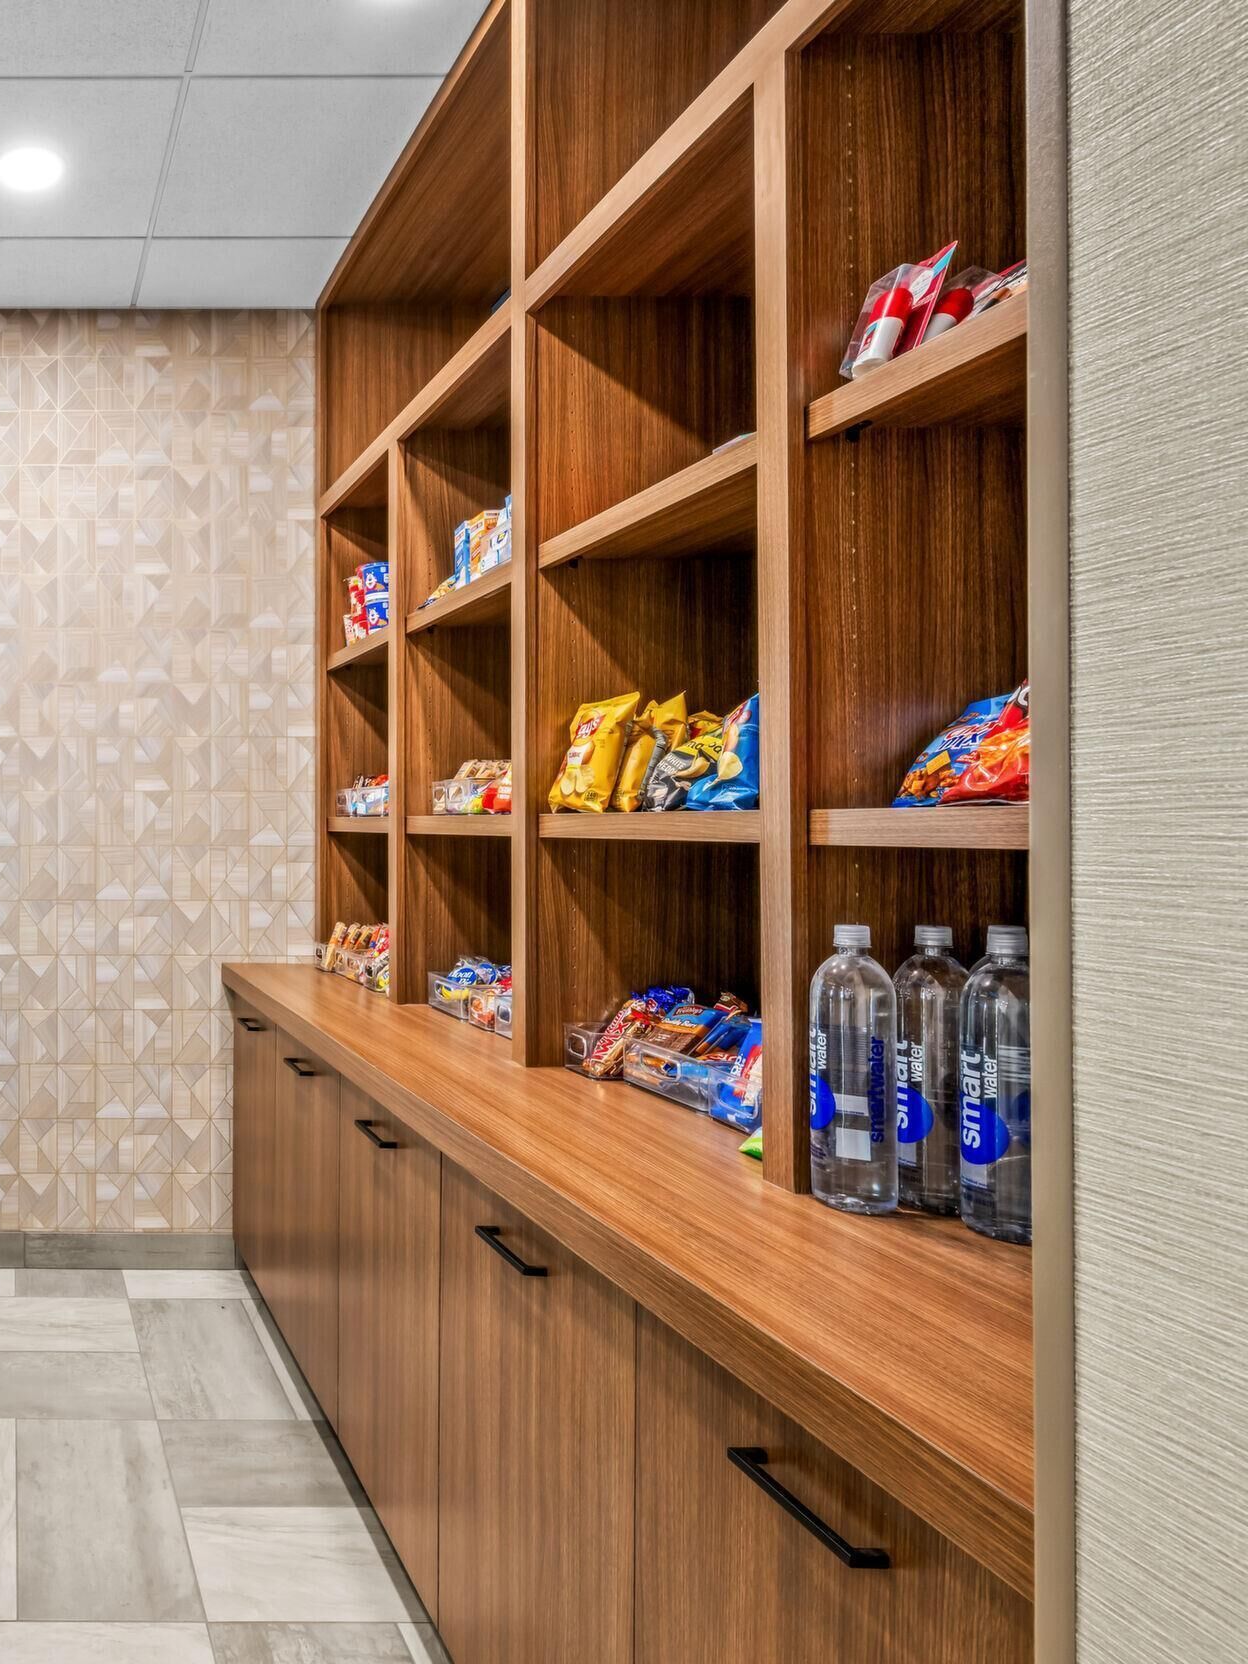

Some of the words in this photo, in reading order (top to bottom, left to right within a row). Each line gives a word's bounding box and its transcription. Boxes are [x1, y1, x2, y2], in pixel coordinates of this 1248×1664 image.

[816, 1029, 827, 1070] water
[909, 1041, 923, 1082] water
[868, 1036, 885, 1143] smartwater
[982, 1055, 997, 1098] water
[961, 1050, 981, 1149] smart
